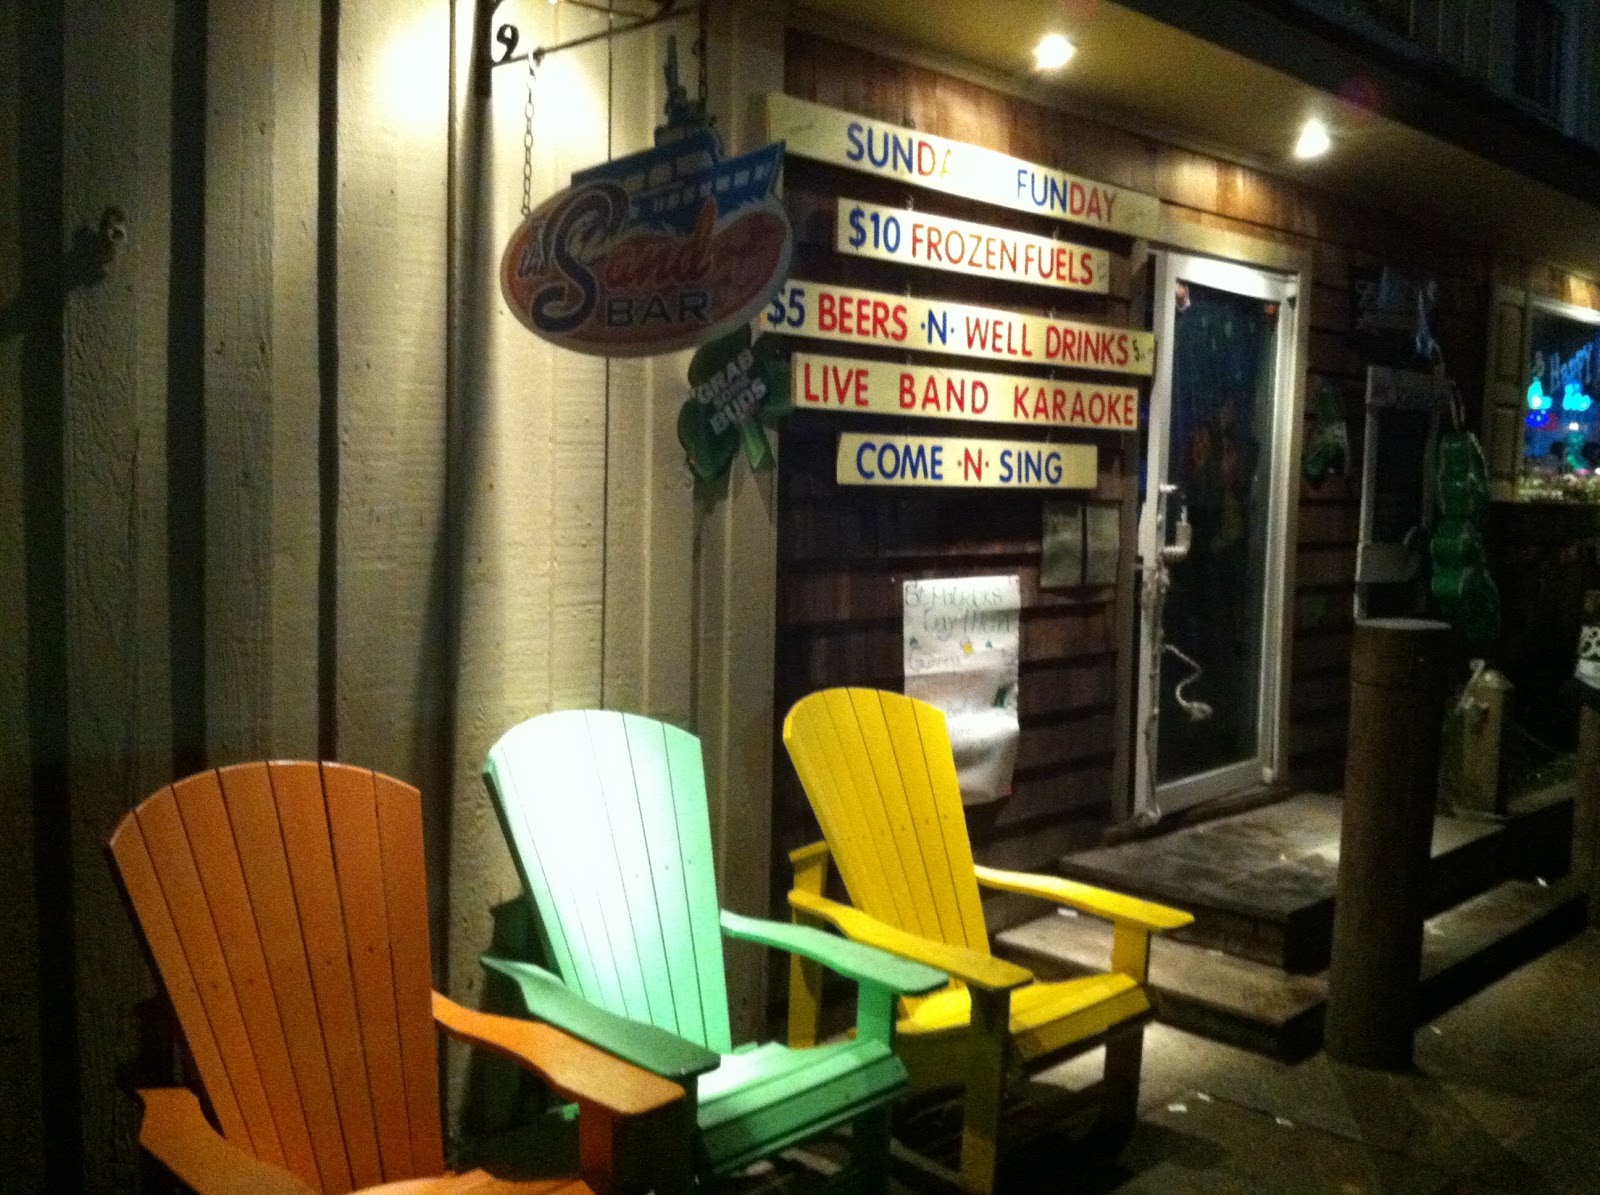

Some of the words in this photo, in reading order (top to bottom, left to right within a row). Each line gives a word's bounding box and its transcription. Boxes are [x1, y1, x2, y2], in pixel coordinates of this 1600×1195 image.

[1016, 168, 1119, 223] FUNDAY
[848, 206, 901, 253] $10
[911, 223, 1018, 273] FROZEN
[1025, 243, 1094, 285] FUELS
[606, 290, 711, 327] BAR
[766, 287, 806, 329] $5
[817, 292, 908, 341] BEERS
[965, 316, 1033, 357] WELL
[1044, 326, 1130, 367] DRINKS
[804, 363, 869, 406] LIVE
[899, 373, 989, 414] BAND
[1013, 385, 1135, 426] KARAOKE
[856, 441, 944, 480] COME
[999, 450, 1063, 484] SING
